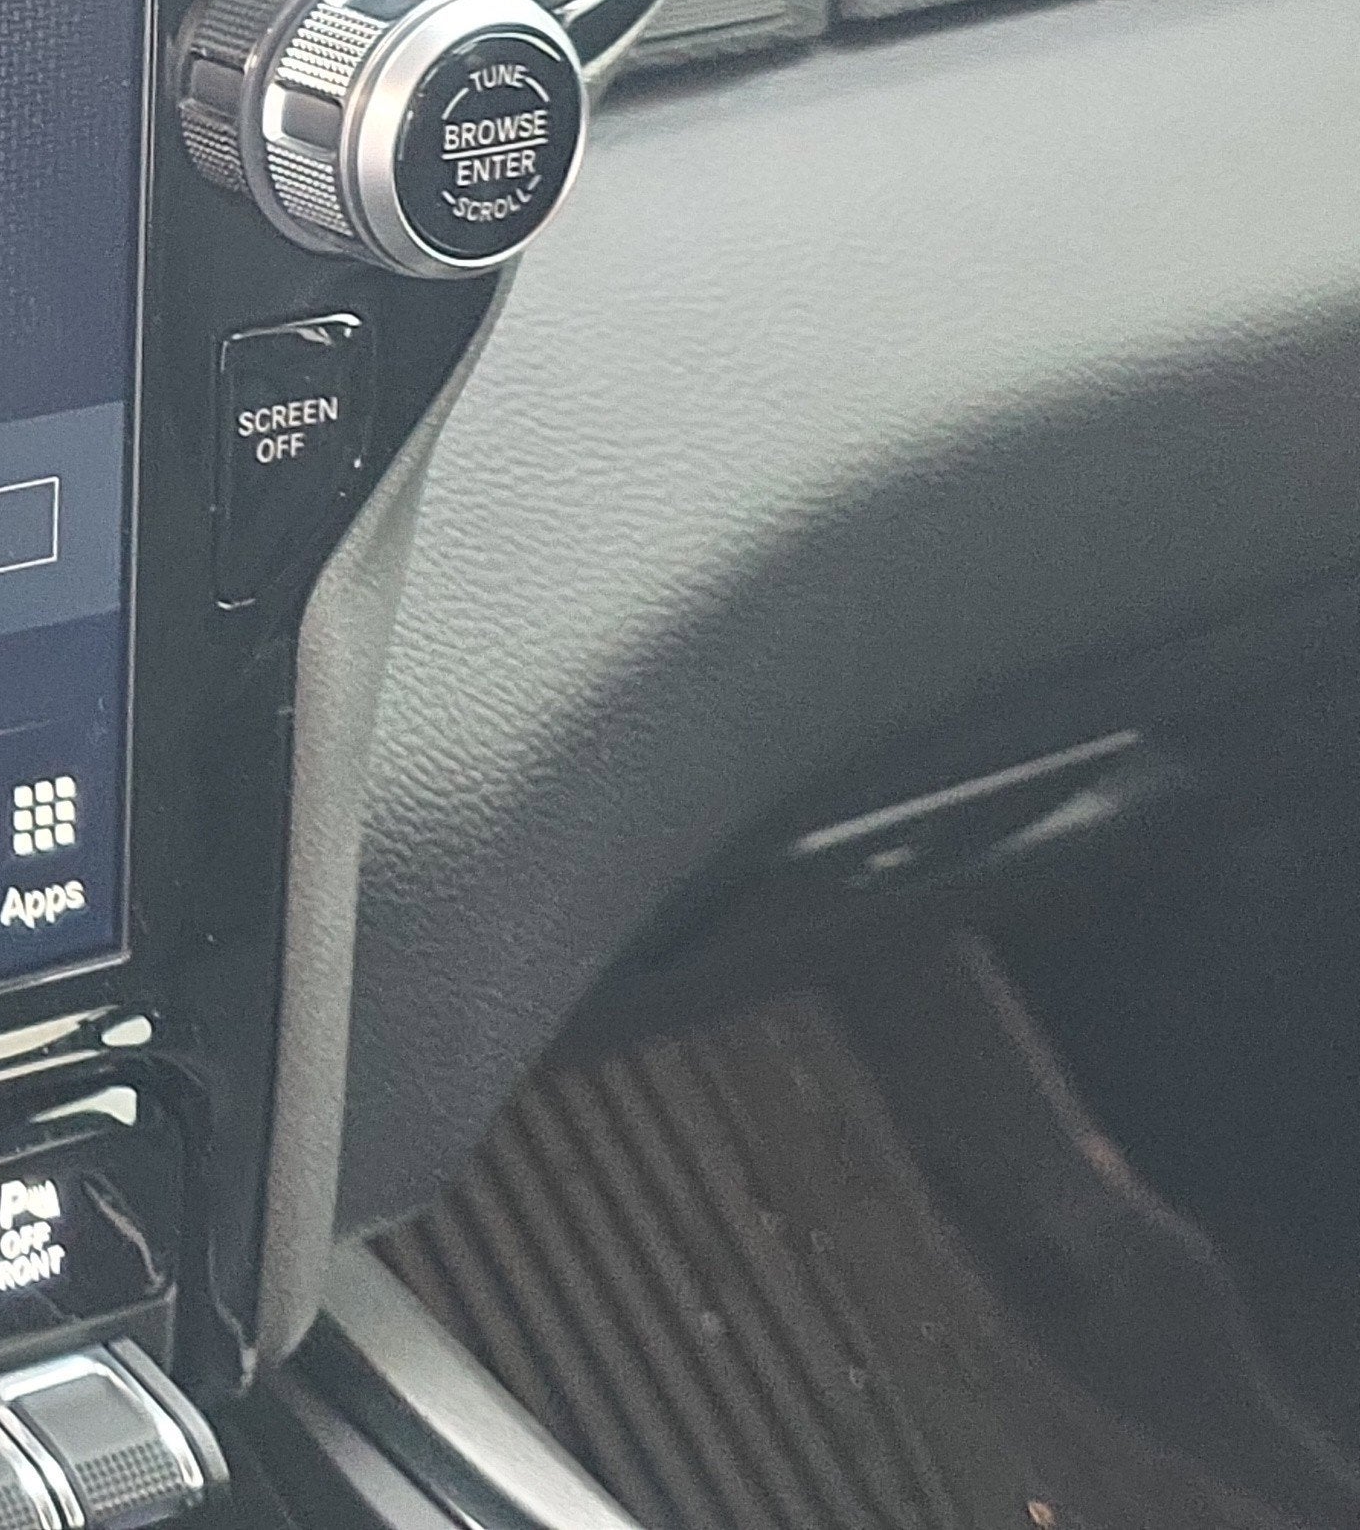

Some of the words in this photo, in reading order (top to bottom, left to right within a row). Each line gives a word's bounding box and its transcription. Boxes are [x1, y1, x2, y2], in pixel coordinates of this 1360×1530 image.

[470, 64, 526, 91] TUNE
[444, 109, 548, 149] BROWSE
[457, 150, 537, 187] ENTER
[452, 187, 532, 221] SCROLL
[238, 397, 339, 437] SCREEN
[256, 433, 305, 464] OFF
[0, 878, 86, 931] Apps
[0, 1221, 52, 1260] OFF
